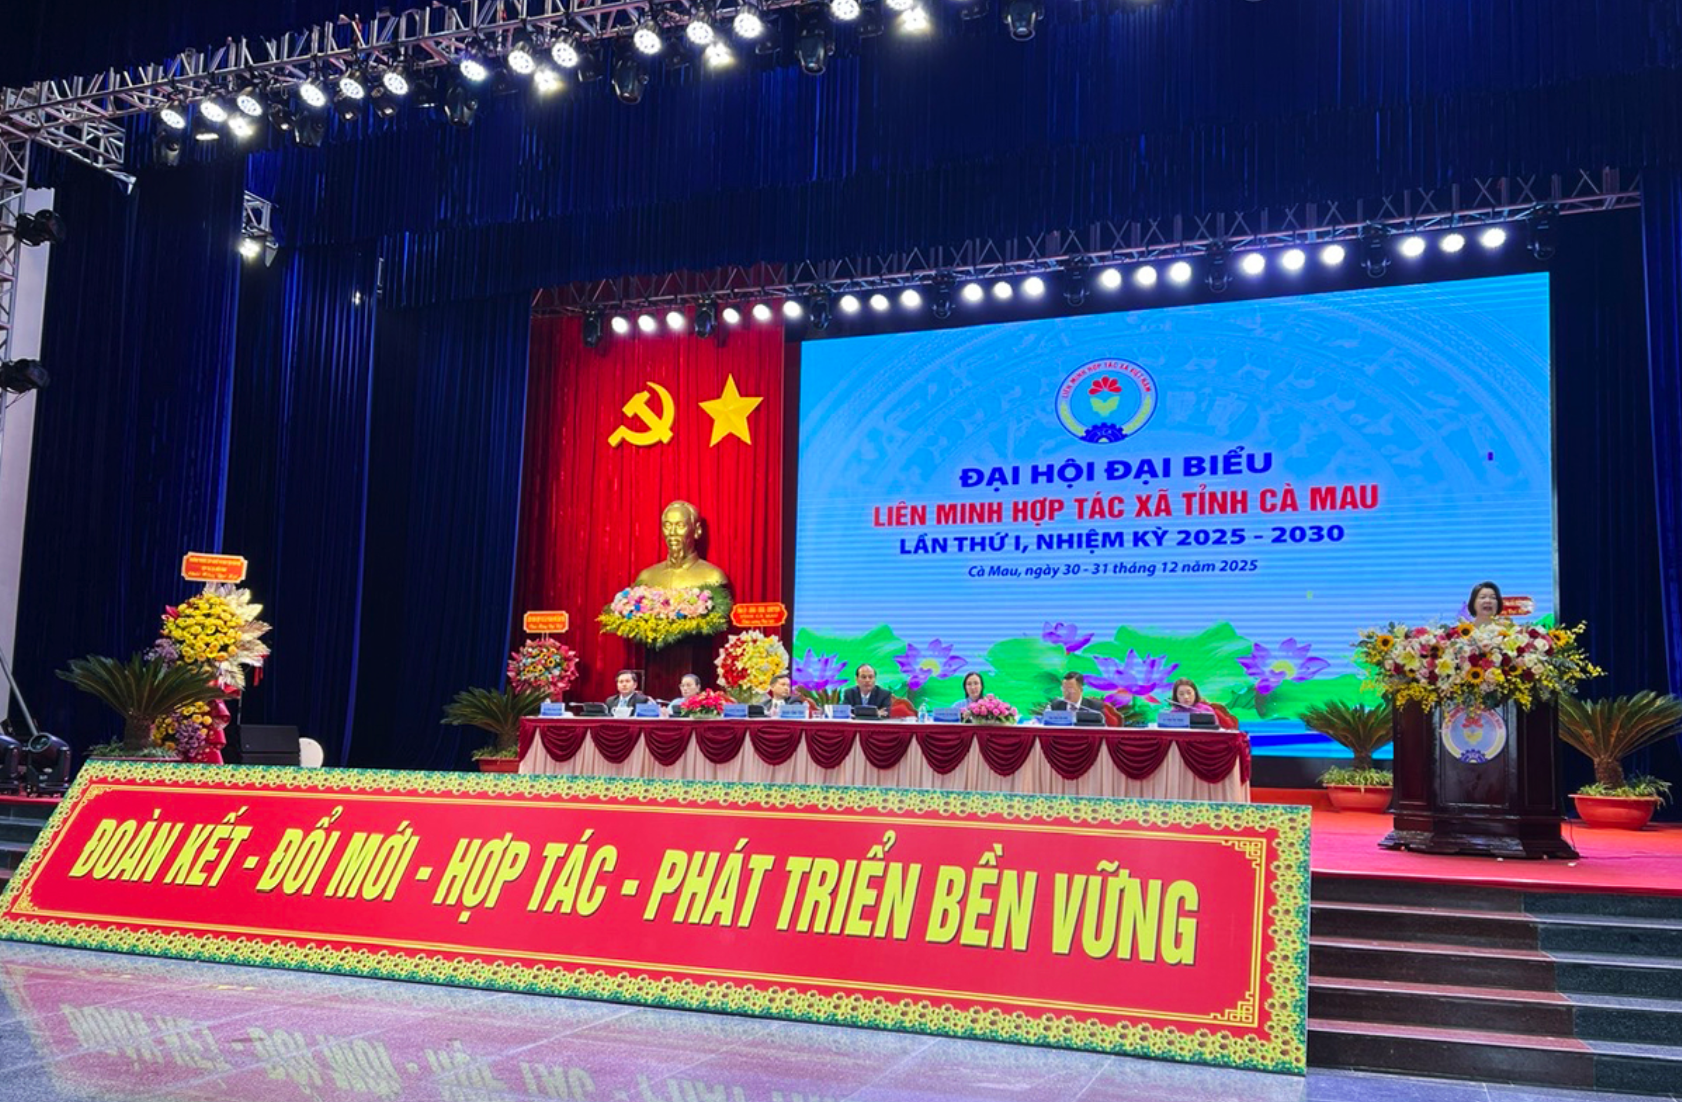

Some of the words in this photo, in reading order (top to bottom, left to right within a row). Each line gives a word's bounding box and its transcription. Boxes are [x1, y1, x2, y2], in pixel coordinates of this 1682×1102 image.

[958, 465, 1021, 492] ĐẠI
[1030, 457, 1096, 489] HỘI
[1103, 456, 1172, 486] ĐẠI
[1182, 445, 1274, 477] BIỂU
[873, 500, 928, 527] LIÊN
[935, 501, 1004, 526] MINH
[1011, 496, 1065, 526] HỢP
[1073, 491, 1125, 520] TÁC
[1134, 488, 1173, 517] XÃ
[1181, 483, 1249, 516] TỈNH
[1259, 482, 1299, 513] CÀ
[1309, 483, 1379, 512] MAU
[899, 532, 949, 555] LẦN
[953, 531, 1009, 553] THỨ
[1014, 534, 1029, 554] I,
[1036, 528, 1126, 555] NHIỆM
[1132, 526, 1169, 548] KỲ
[1176, 528, 1247, 547] 2025
[1271, 524, 1345, 544] 2030
[967, 564, 986, 578] Cà
[987, 564, 1022, 578] Mau,
[1024, 563, 1060, 580] ngày
[1062, 563, 1081, 576] 30
[1091, 562, 1109, 575] 31
[1112, 560, 1157, 578] tháng
[1161, 560, 1179, 574] 12
[1180, 560, 1216, 573] năm
[1218, 559, 1259, 573] 2025
[68, 808, 184, 882] ĐOÀN
[162, 805, 253, 888] KẾT
[255, 805, 343, 895] ĐỔI
[323, 820, 420, 901] MỚI
[432, 832, 531, 923] HỢP
[526, 828, 618, 916] TÁC
[642, 837, 775, 928] PHÁT
[775, 829, 922, 940] TRIỂN
[925, 843, 1039, 951] BỀN
[1051, 859, 1200, 965] VỮNG
